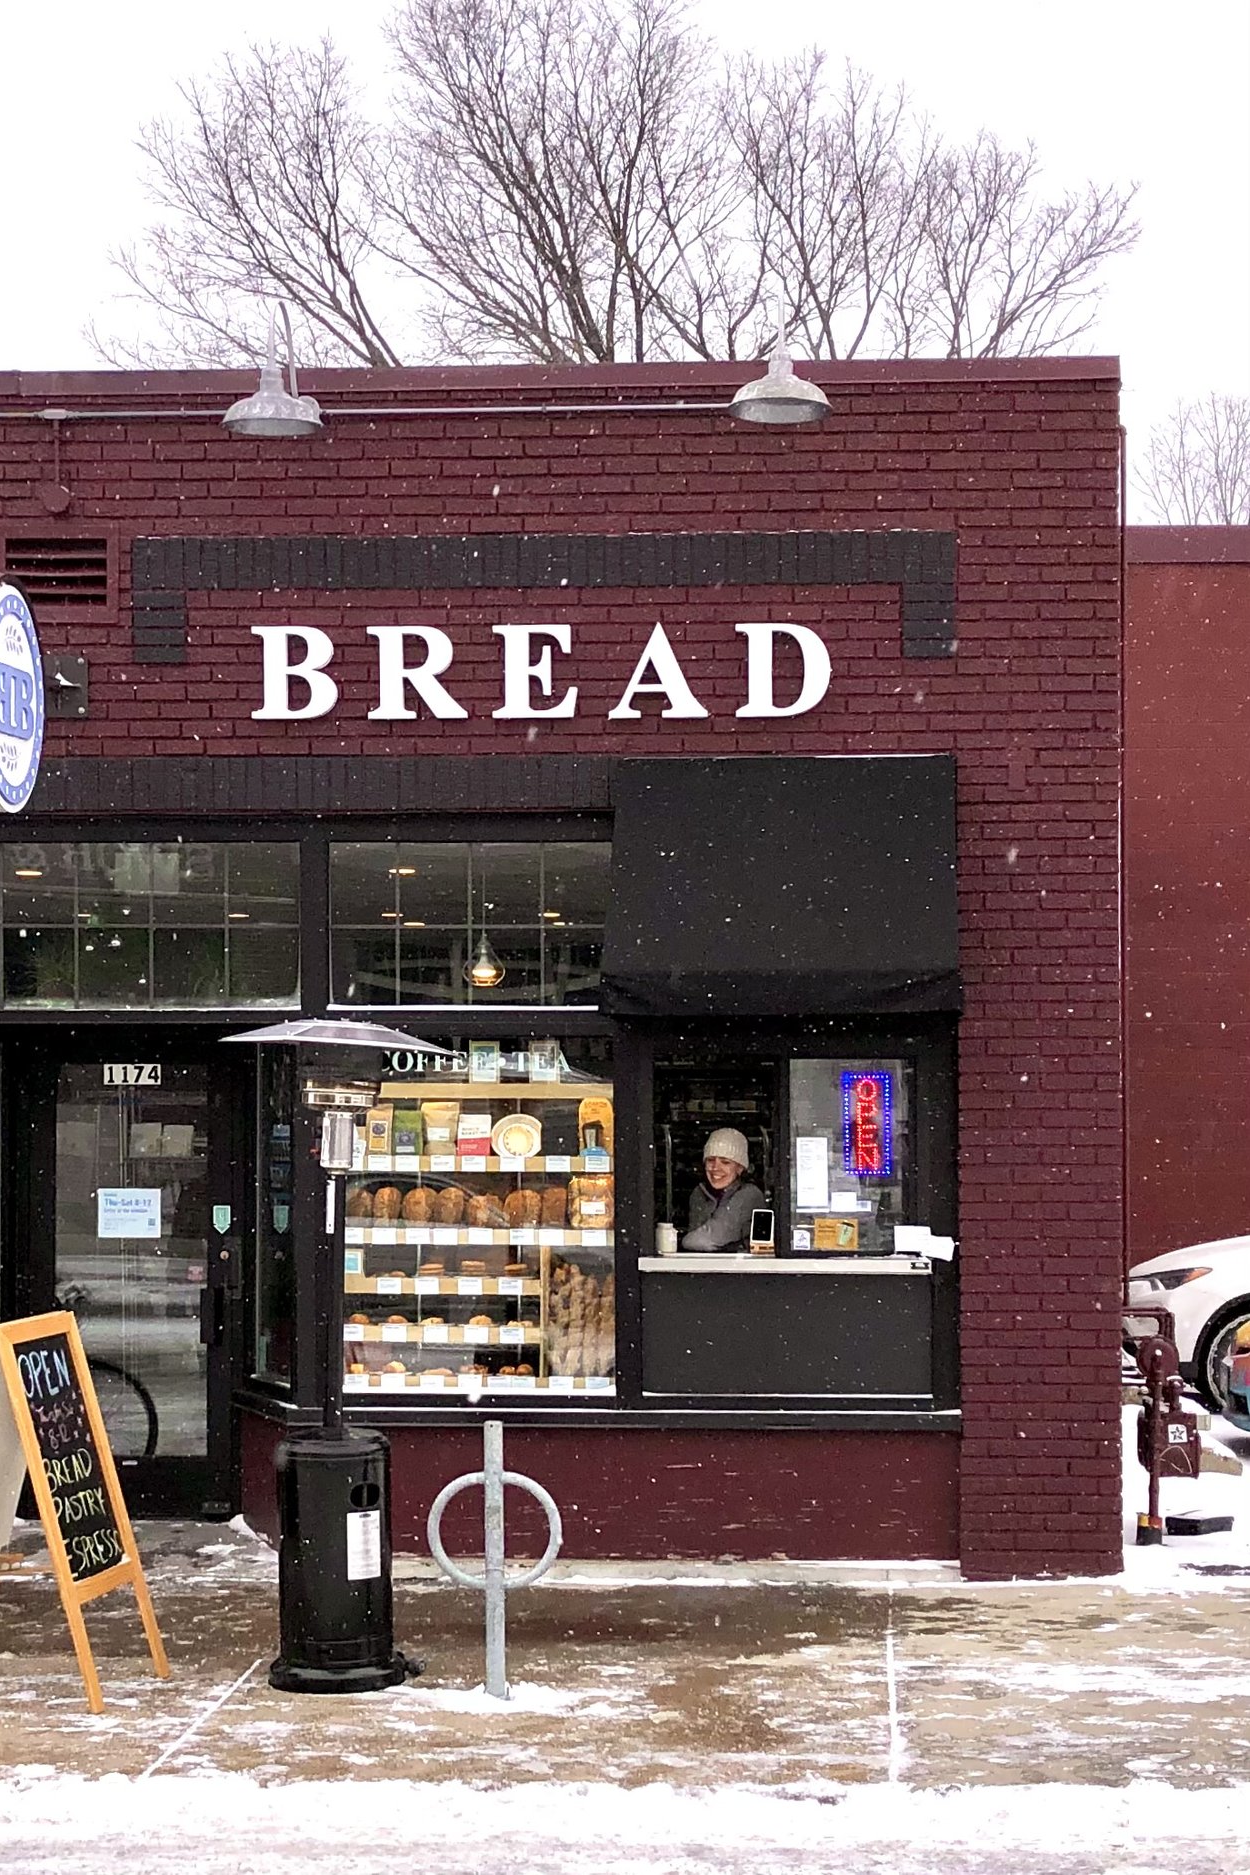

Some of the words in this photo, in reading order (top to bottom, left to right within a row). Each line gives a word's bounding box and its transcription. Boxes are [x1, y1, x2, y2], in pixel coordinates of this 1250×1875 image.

[250, 620, 833, 720] BREAD
[107, 1065, 160, 1084] 1174
[512, 1050, 572, 1073] TEA
[856, 1078, 879, 1171] OPEN
[18, 1349, 71, 1399] OPEN
[42, 1448, 92, 1494] BREAD
[52, 1486, 106, 1524] PASTRY
